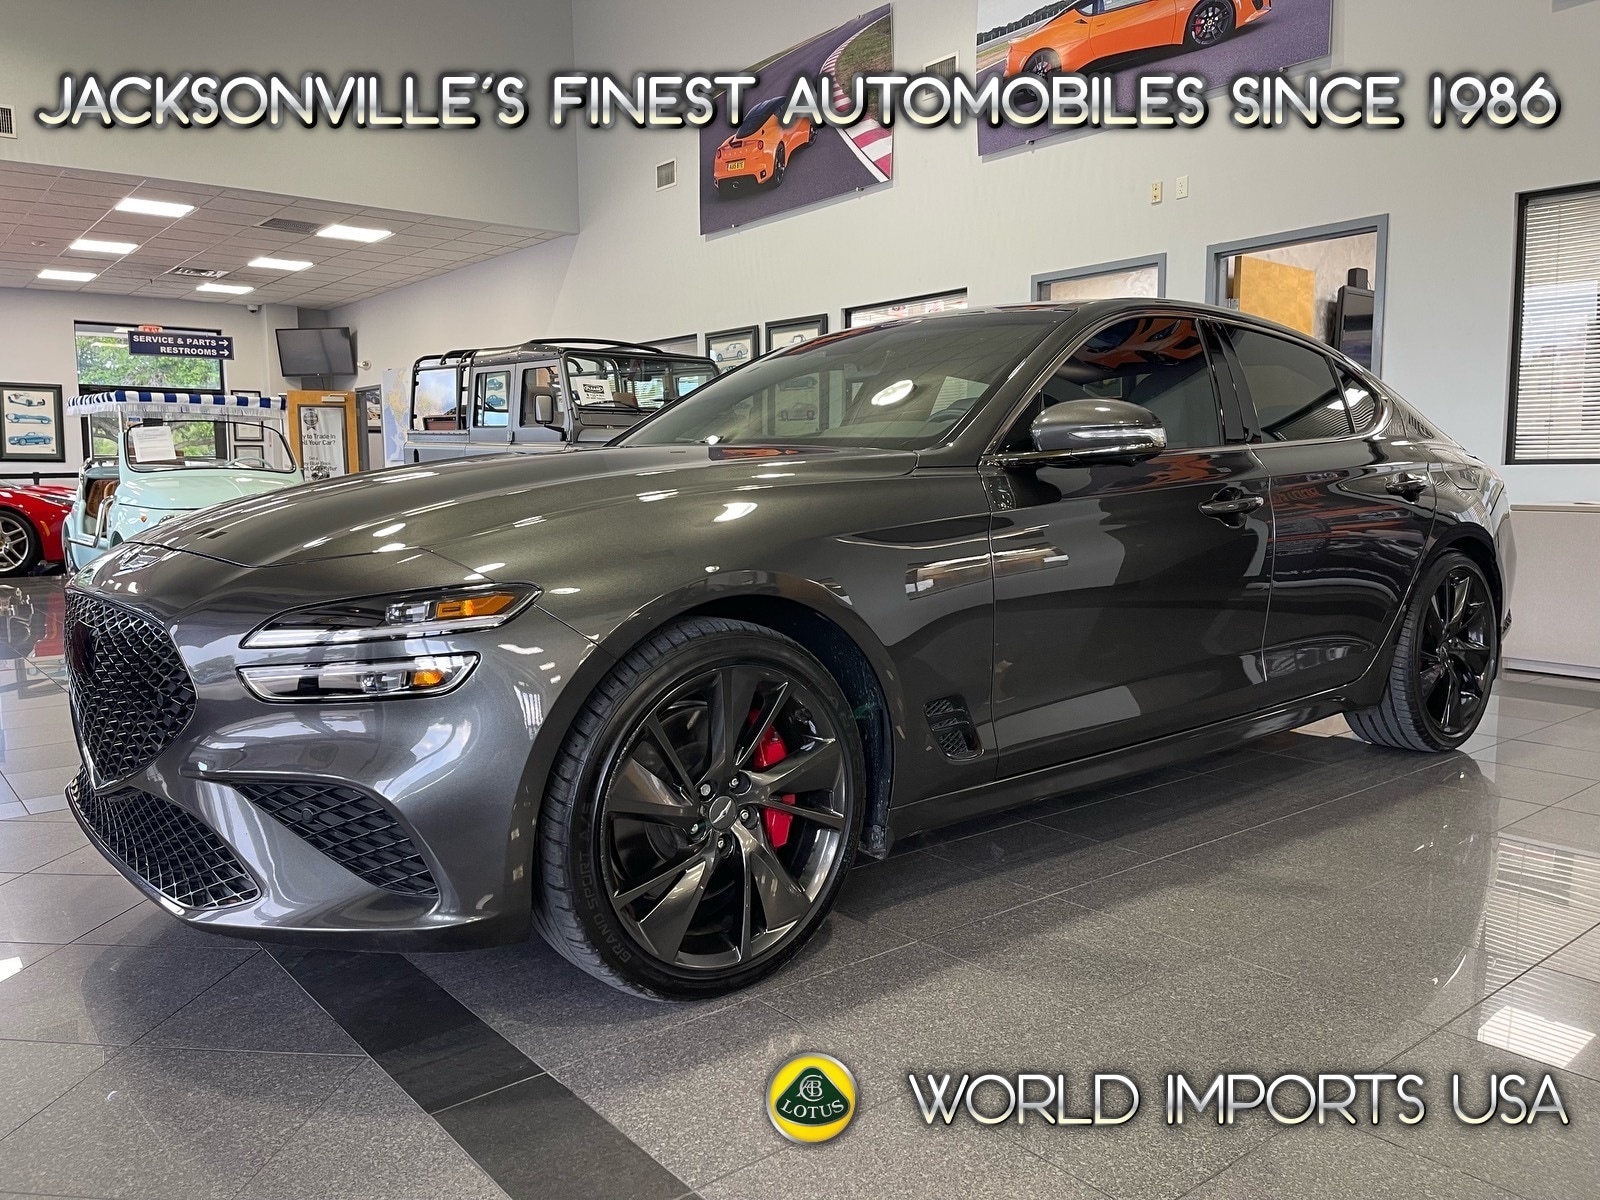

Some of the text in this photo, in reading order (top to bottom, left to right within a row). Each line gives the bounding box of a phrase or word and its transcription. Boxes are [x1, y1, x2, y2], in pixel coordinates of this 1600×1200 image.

[132, 335, 174, 344] SERVICE
[186, 338, 217, 346] PARTS
[160, 346, 217, 356] RESTROOMS
[578, 851, 598, 910] SPORT
[594, 912, 632, 964] GRAND
